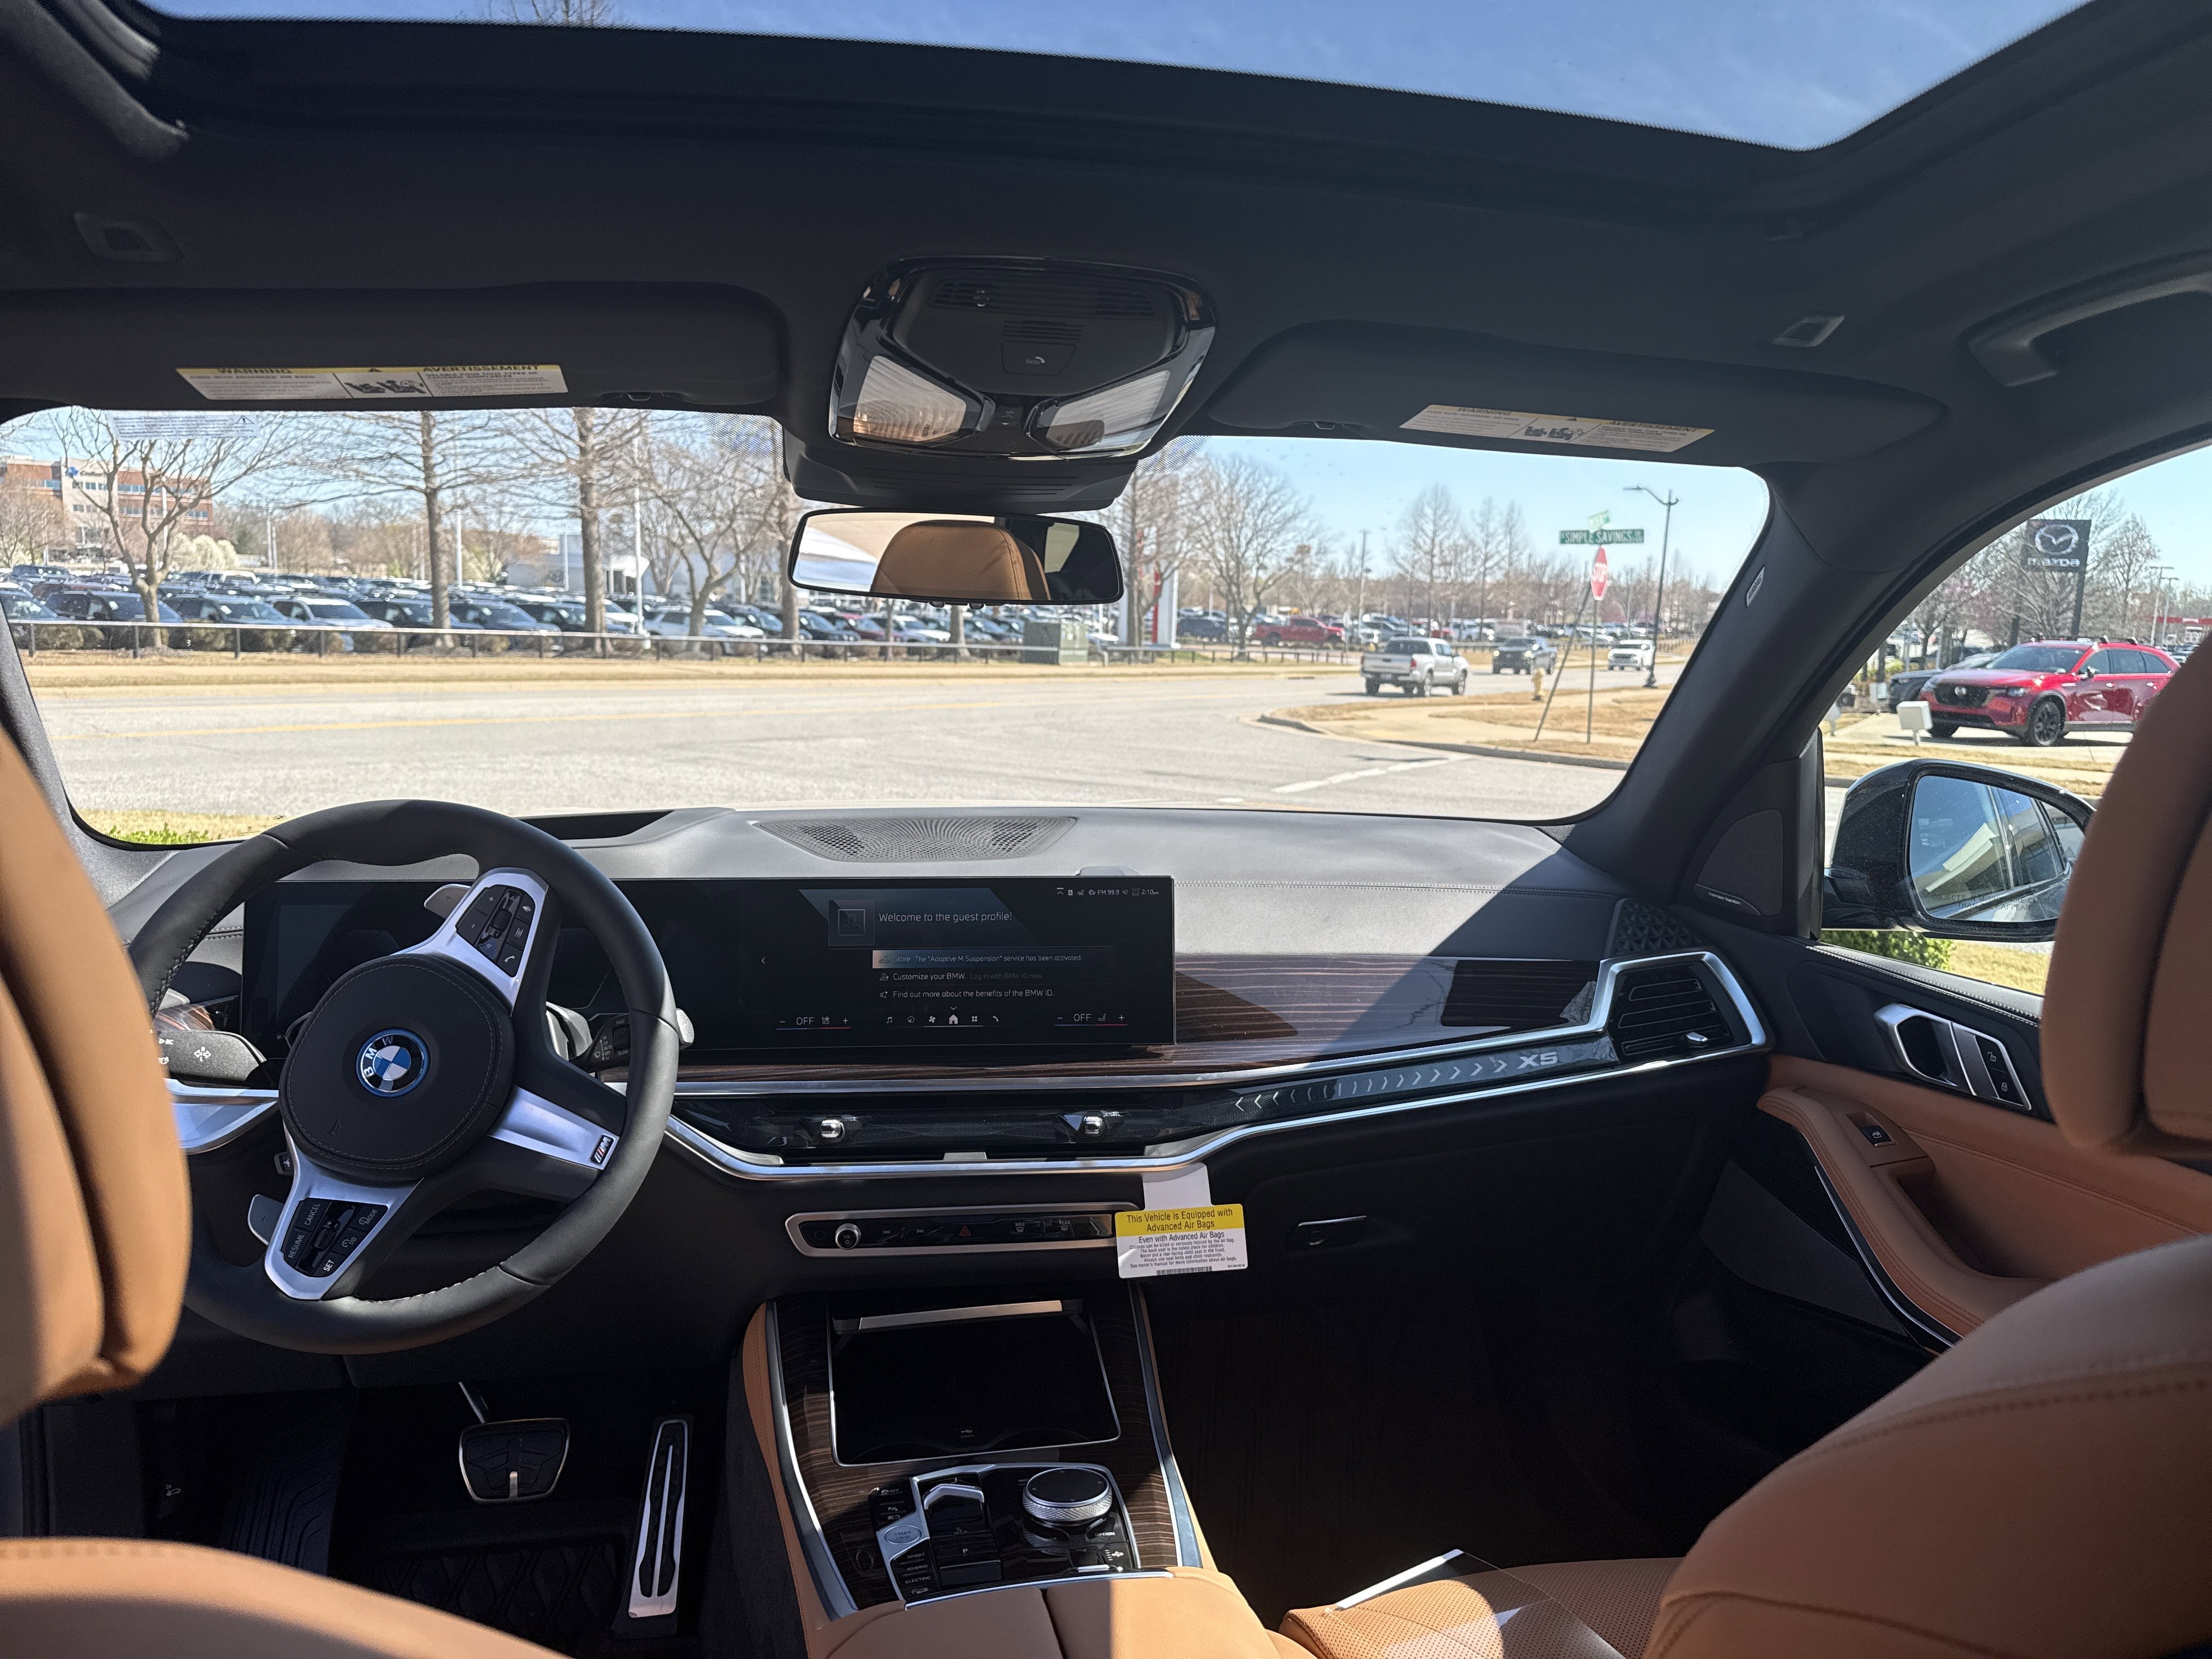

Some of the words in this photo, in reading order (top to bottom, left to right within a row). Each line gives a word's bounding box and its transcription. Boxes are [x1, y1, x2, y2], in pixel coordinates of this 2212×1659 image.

[1458, 408, 1510, 416] WARNING
[1596, 531, 1632, 543] SAVINGS
[879, 912, 921, 922] Welcome
[935, 913, 950, 921] the
[953, 913, 979, 923] guest
[981, 912, 1012, 923] profile!
[363, 1035, 394, 1078] BMW
[1517, 1051, 1558, 1069] X5
[304, 1203, 321, 1226] CANCEL
[364, 1209, 378, 1224] MODE
[1127, 1215, 1142, 1223] This
[1144, 1212, 1171, 1222] Vehicle
[1181, 1210, 1215, 1220] Equipped
[1217, 1208, 1233, 1217] with
[1147, 1222, 1182, 1232] Advanced
[1184, 1221, 1195, 1230] Air
[1197, 1220, 1215, 1230] Bags
[1169, 1232, 1198, 1241] Advanced
[1210, 1231, 1224, 1239] Bags
[288, 1233, 305, 1259] RESUME
[323, 1259, 335, 1272] SET
[905, 1576, 932, 1584] ELECTRIC
